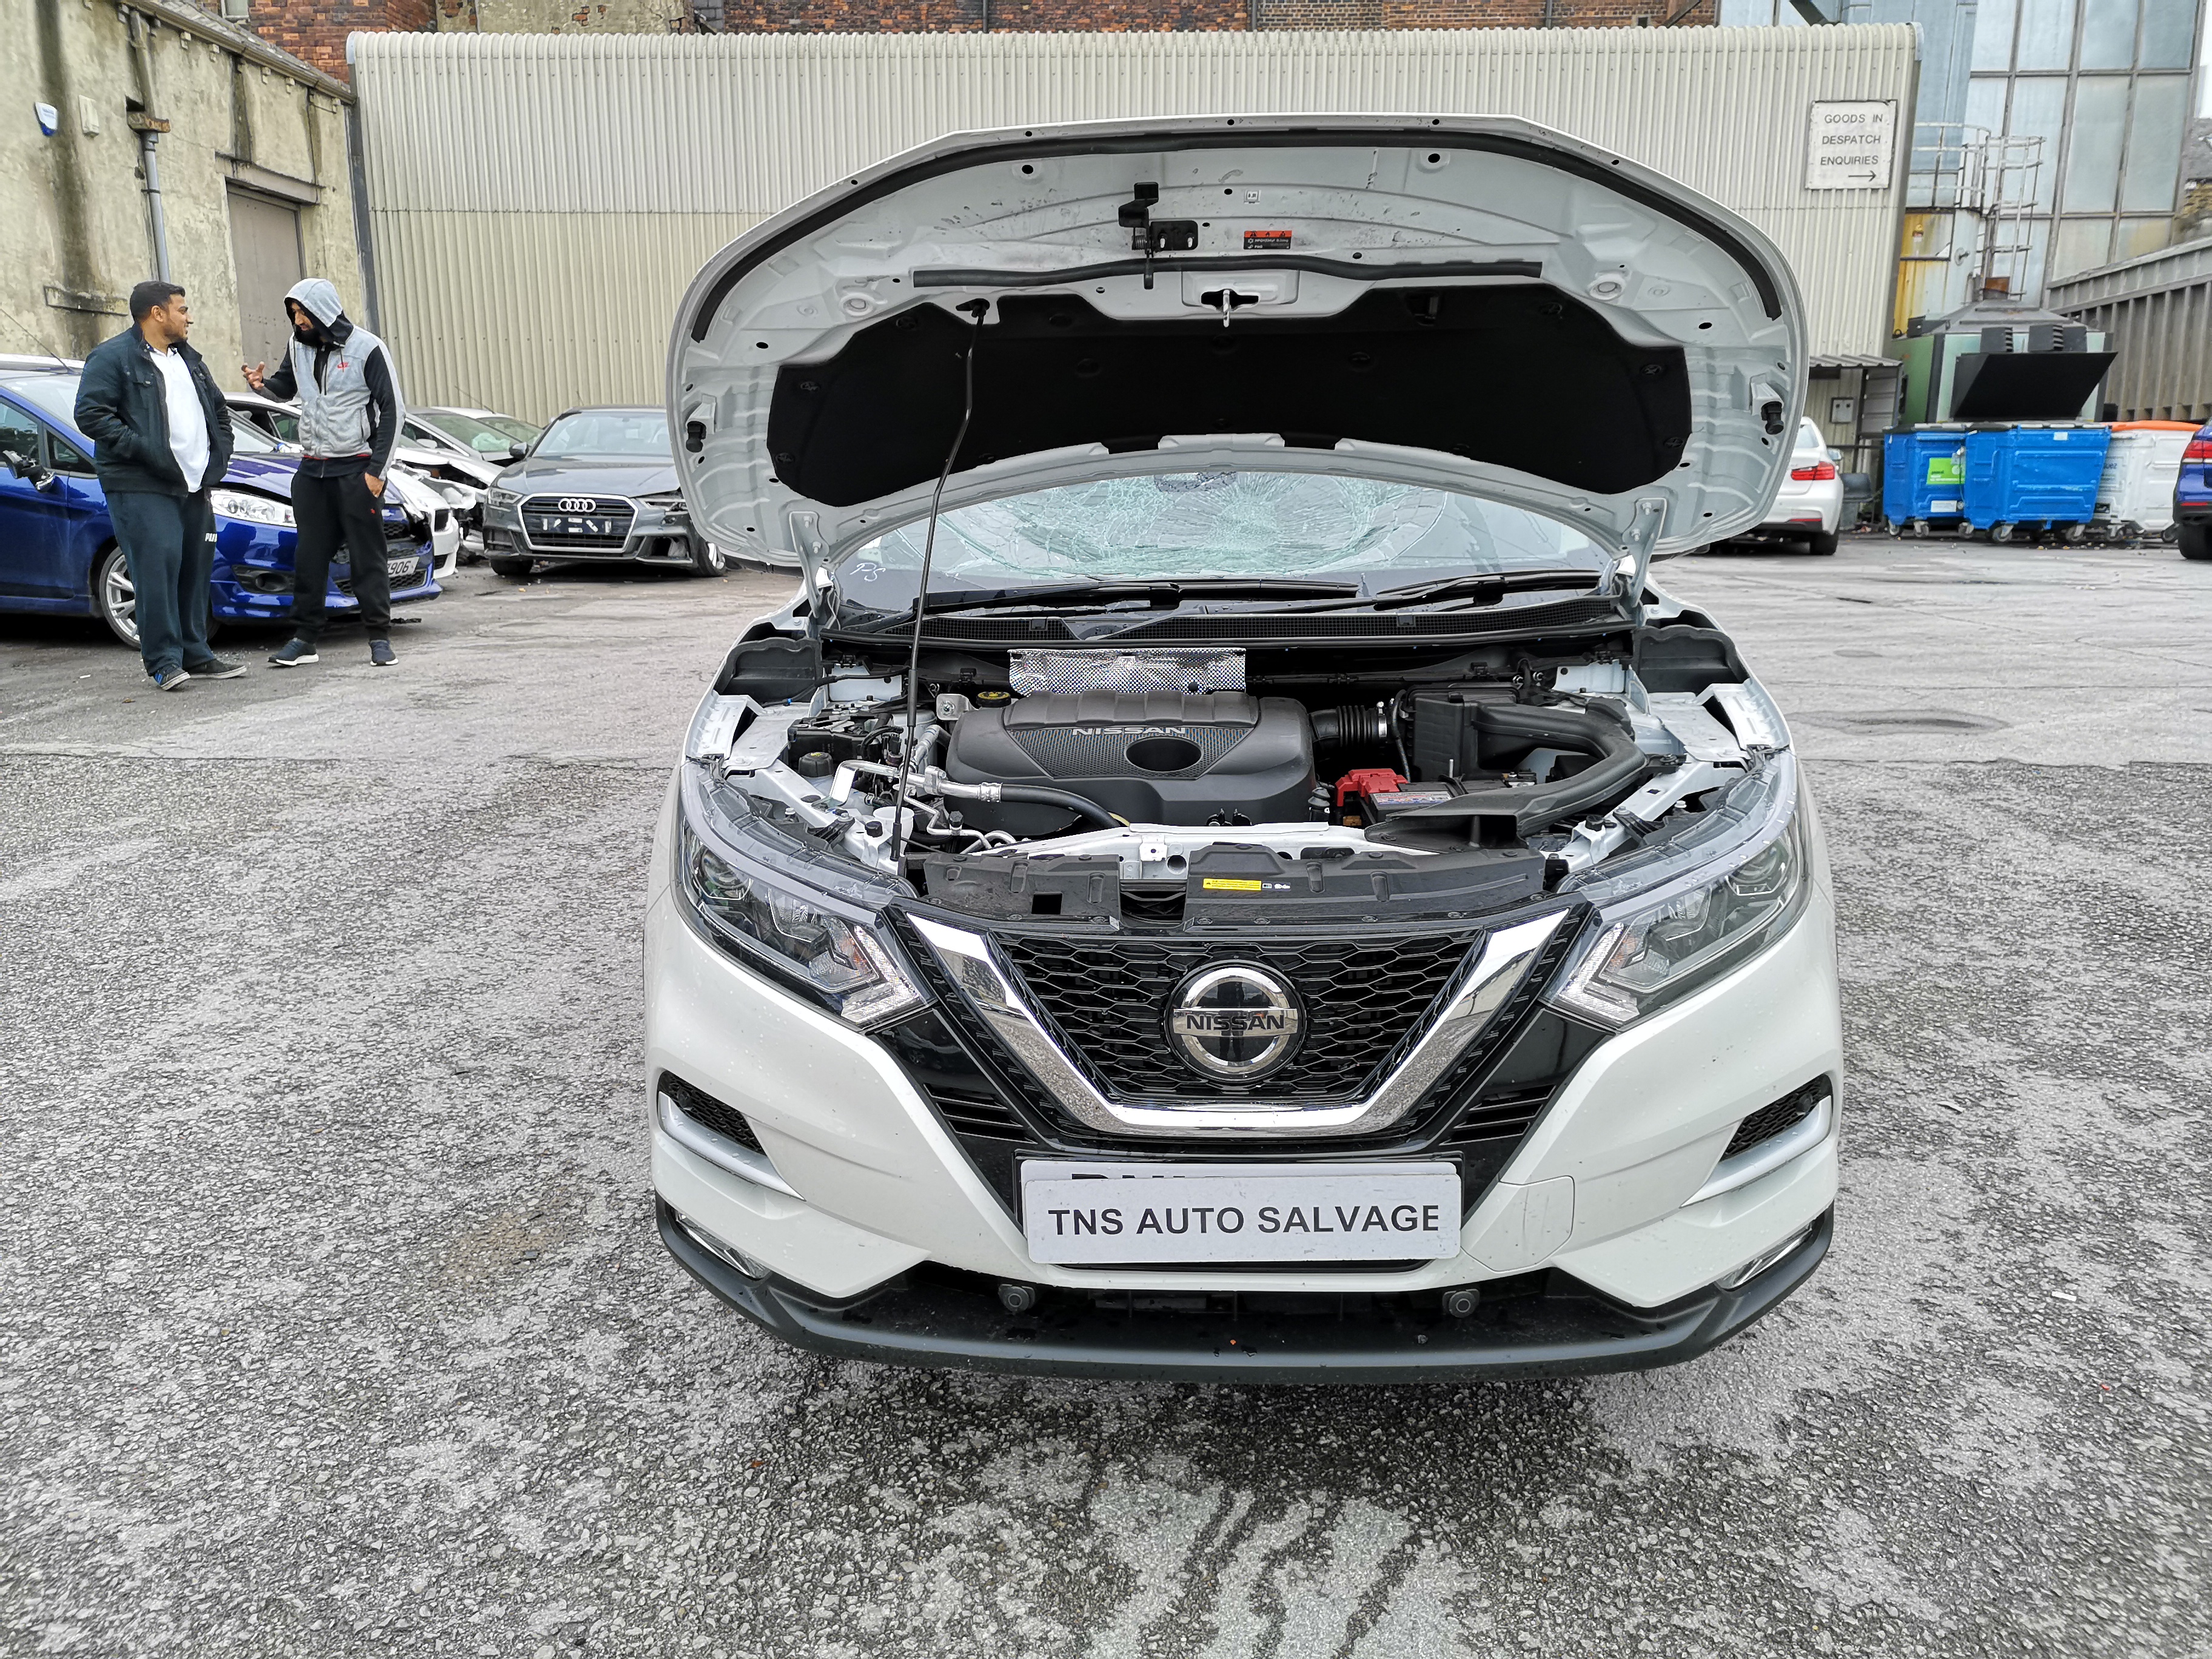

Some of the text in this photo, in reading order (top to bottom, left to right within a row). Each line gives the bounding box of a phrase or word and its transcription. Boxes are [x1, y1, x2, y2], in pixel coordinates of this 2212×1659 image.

[1824, 113, 1883, 124] GOODS IN
[1822, 134, 1882, 145] DESPATCH
[1820, 155, 1879, 166] ENQUIRIES
[1072, 727, 1186, 736] NISSAN
[1186, 1014, 1285, 1031] NISSAN
[1048, 1204, 1439, 1235] TNS AUTO SALVAGE
